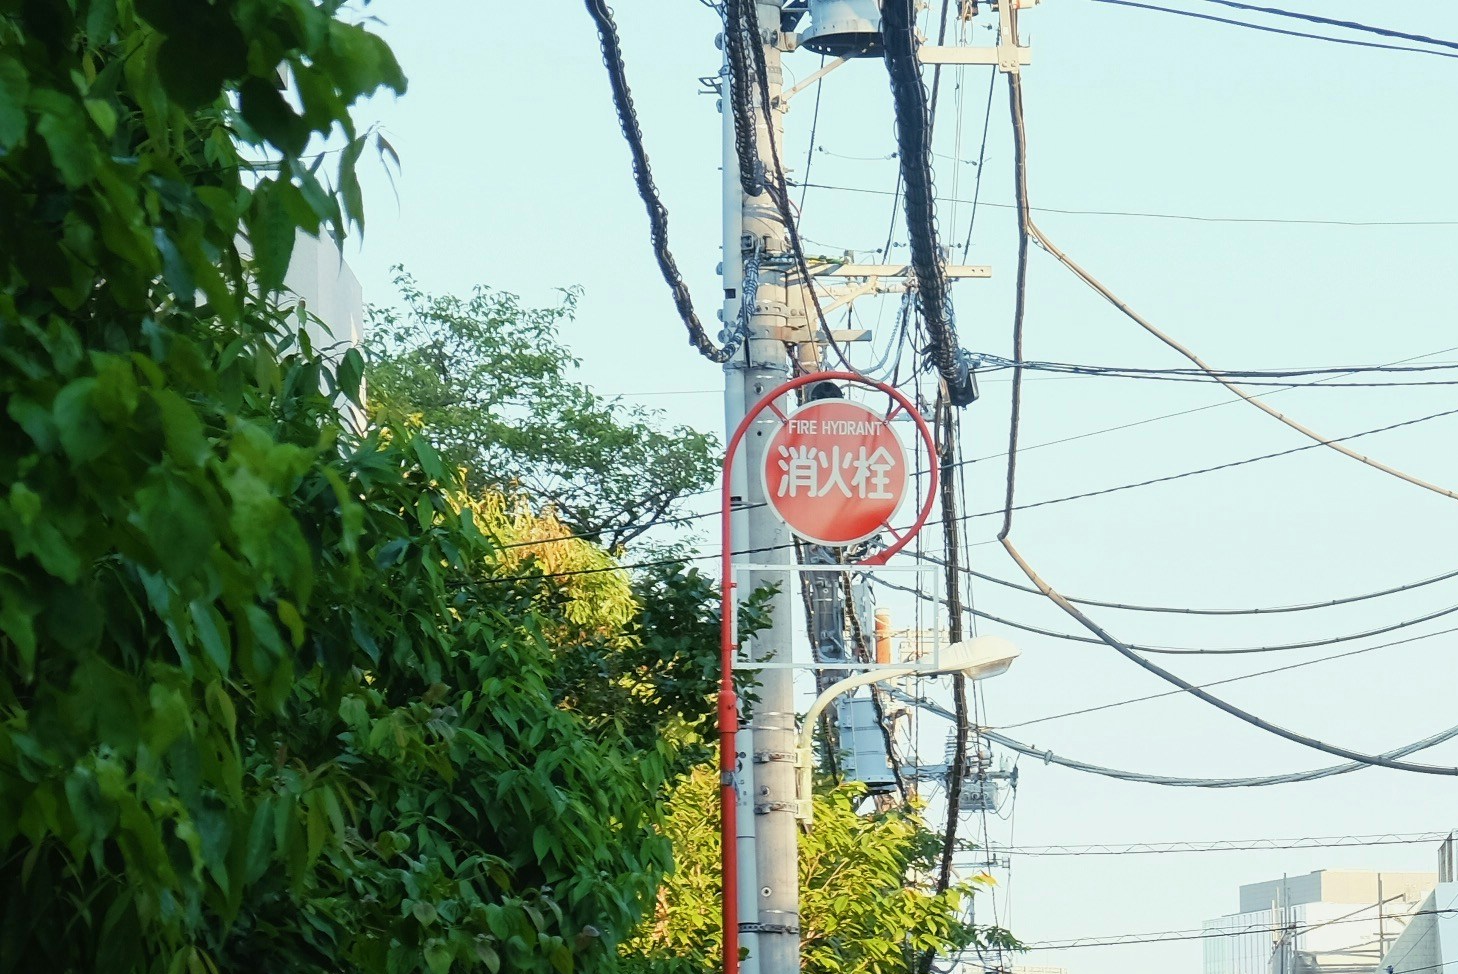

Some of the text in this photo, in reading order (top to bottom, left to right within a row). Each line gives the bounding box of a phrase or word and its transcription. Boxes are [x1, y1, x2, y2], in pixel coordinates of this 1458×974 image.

[789, 420, 882, 436] FIRE HYDRANT
[777, 444, 896, 500] 消火栓
